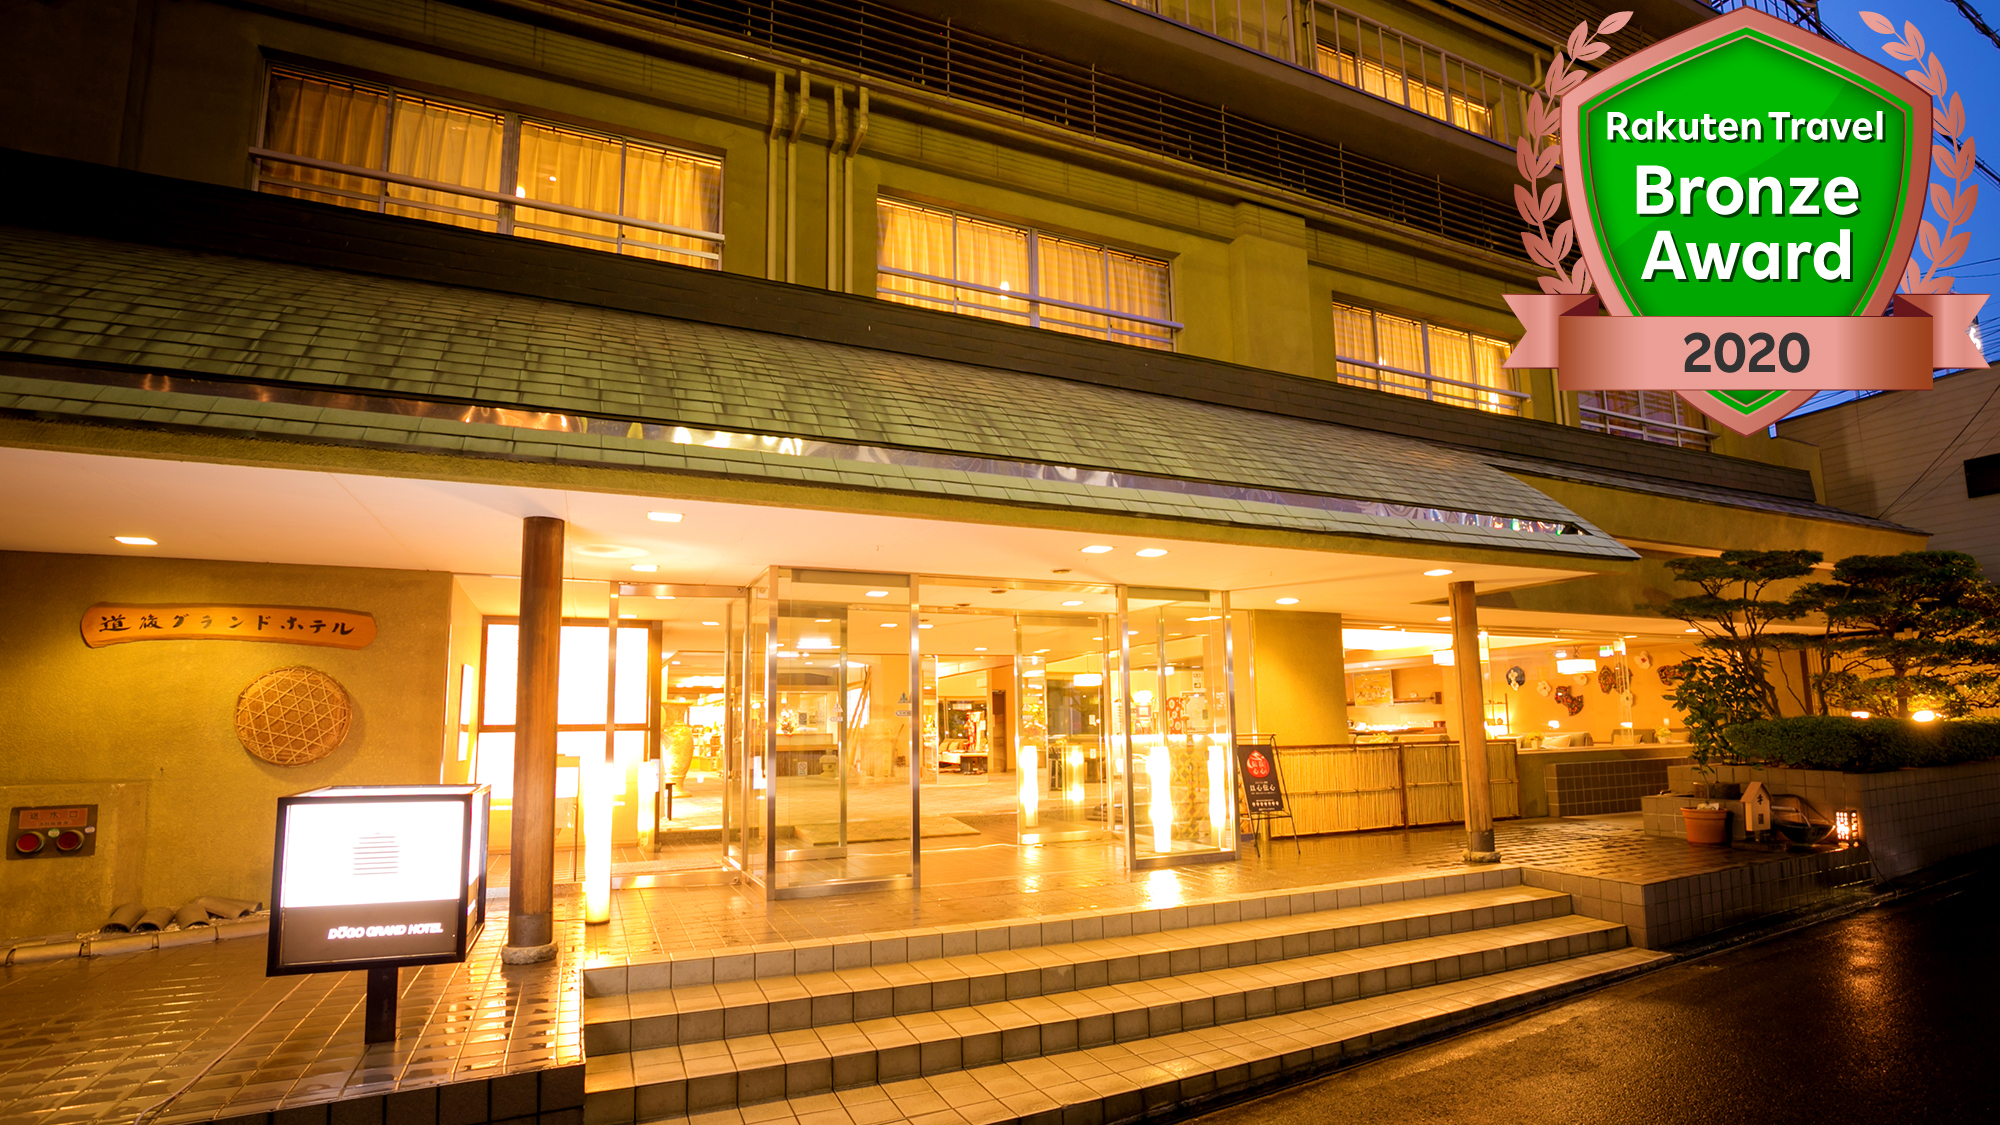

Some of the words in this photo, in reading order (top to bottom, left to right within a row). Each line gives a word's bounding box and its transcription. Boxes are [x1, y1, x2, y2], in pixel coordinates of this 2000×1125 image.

[99, 612, 356, 636] 道後グランドホテル
[366, 924, 407, 937] GRAND
[408, 922, 444, 935] HOTEL
